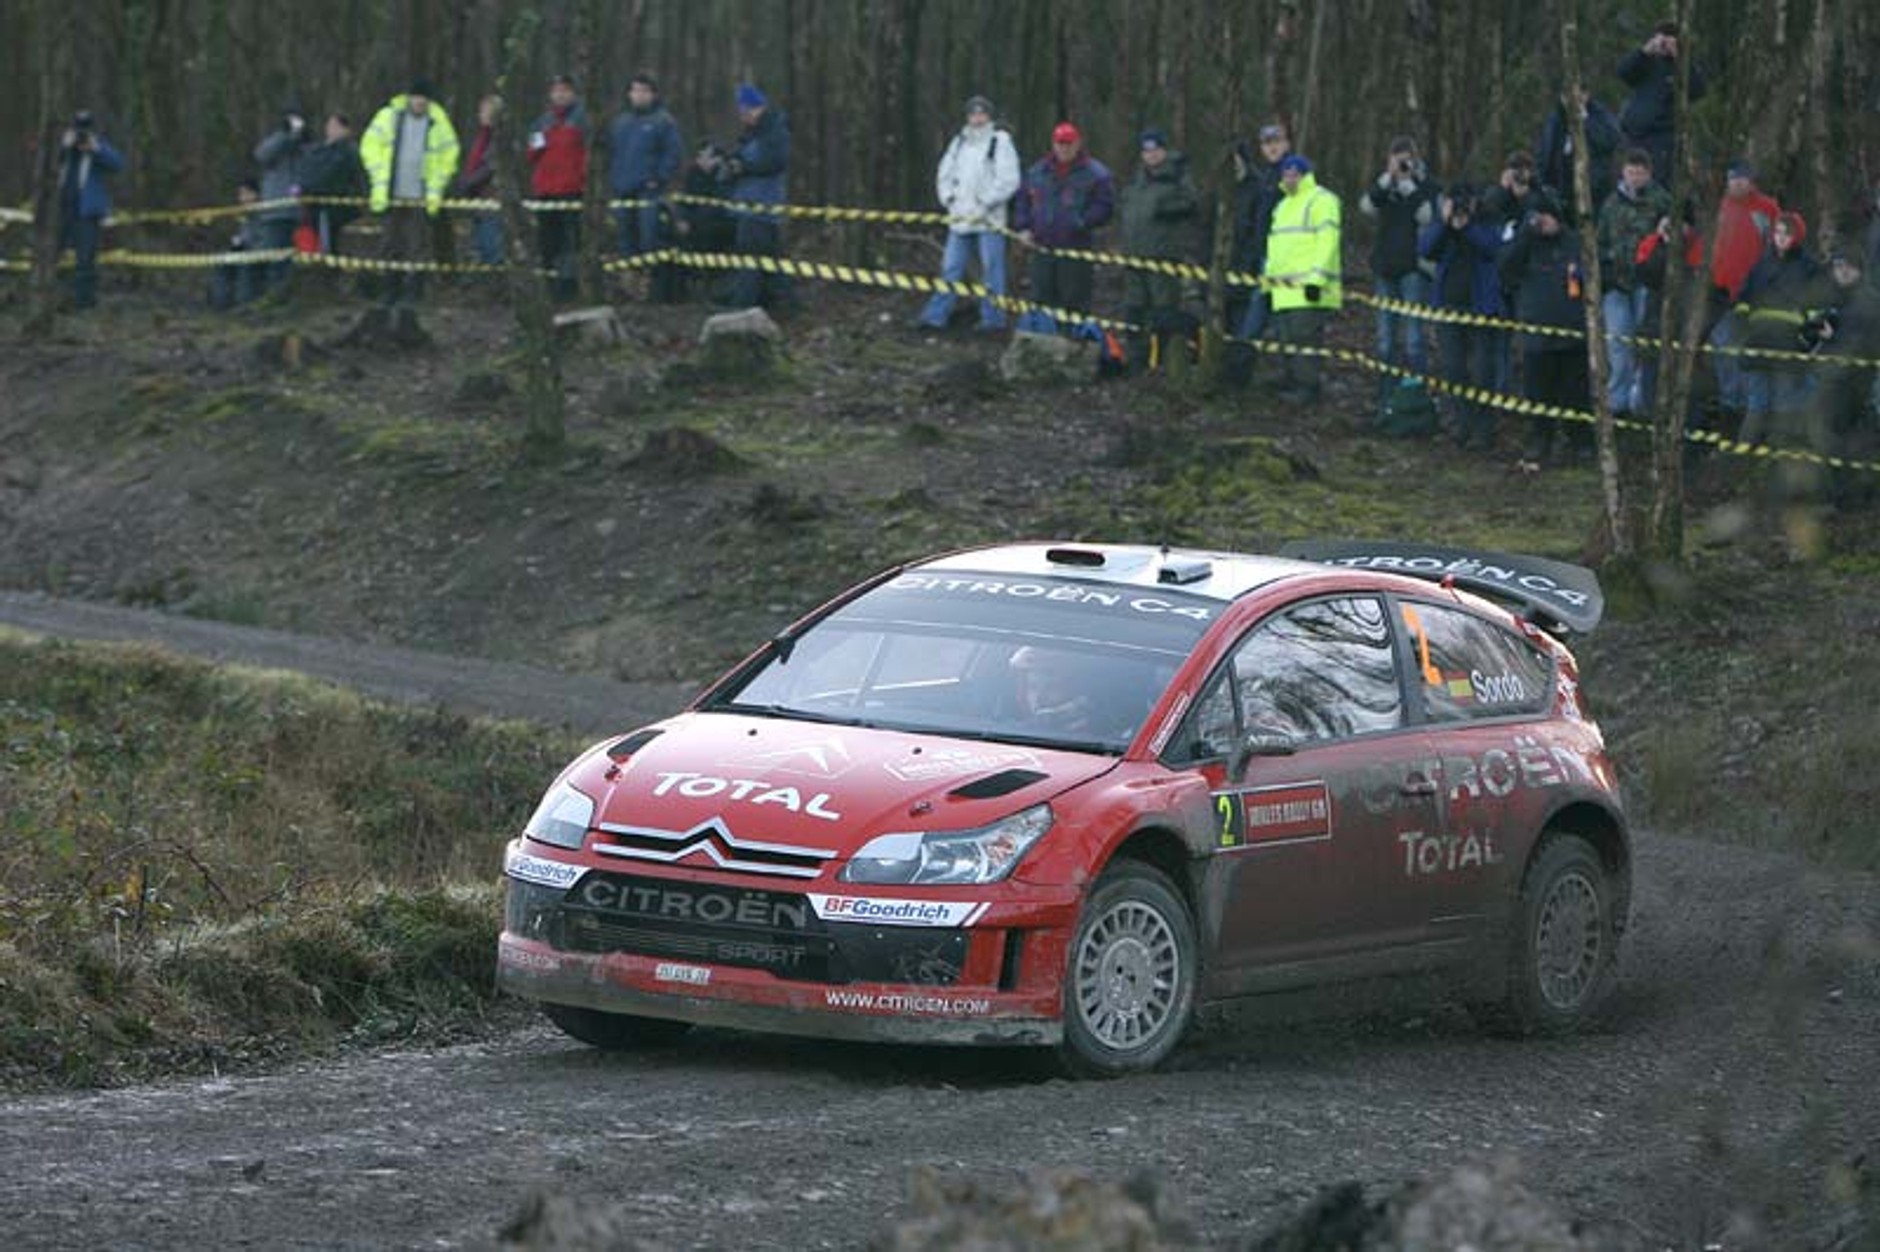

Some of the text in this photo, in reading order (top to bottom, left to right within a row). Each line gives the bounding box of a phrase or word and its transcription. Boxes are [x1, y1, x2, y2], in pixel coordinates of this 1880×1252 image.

[886, 574, 1212, 620] CITROËN C4
[1518, 574, 1589, 607] C4
[1471, 668, 1525, 703] Sordo
[653, 772, 841, 821] TOTAL
[1218, 795, 1235, 847] 2
[1399, 827, 1504, 876] TOTAL
[583, 880, 807, 927] CITROËN
[824, 898, 950, 920] BFGoodrich
[715, 942, 806, 966] SPORT
